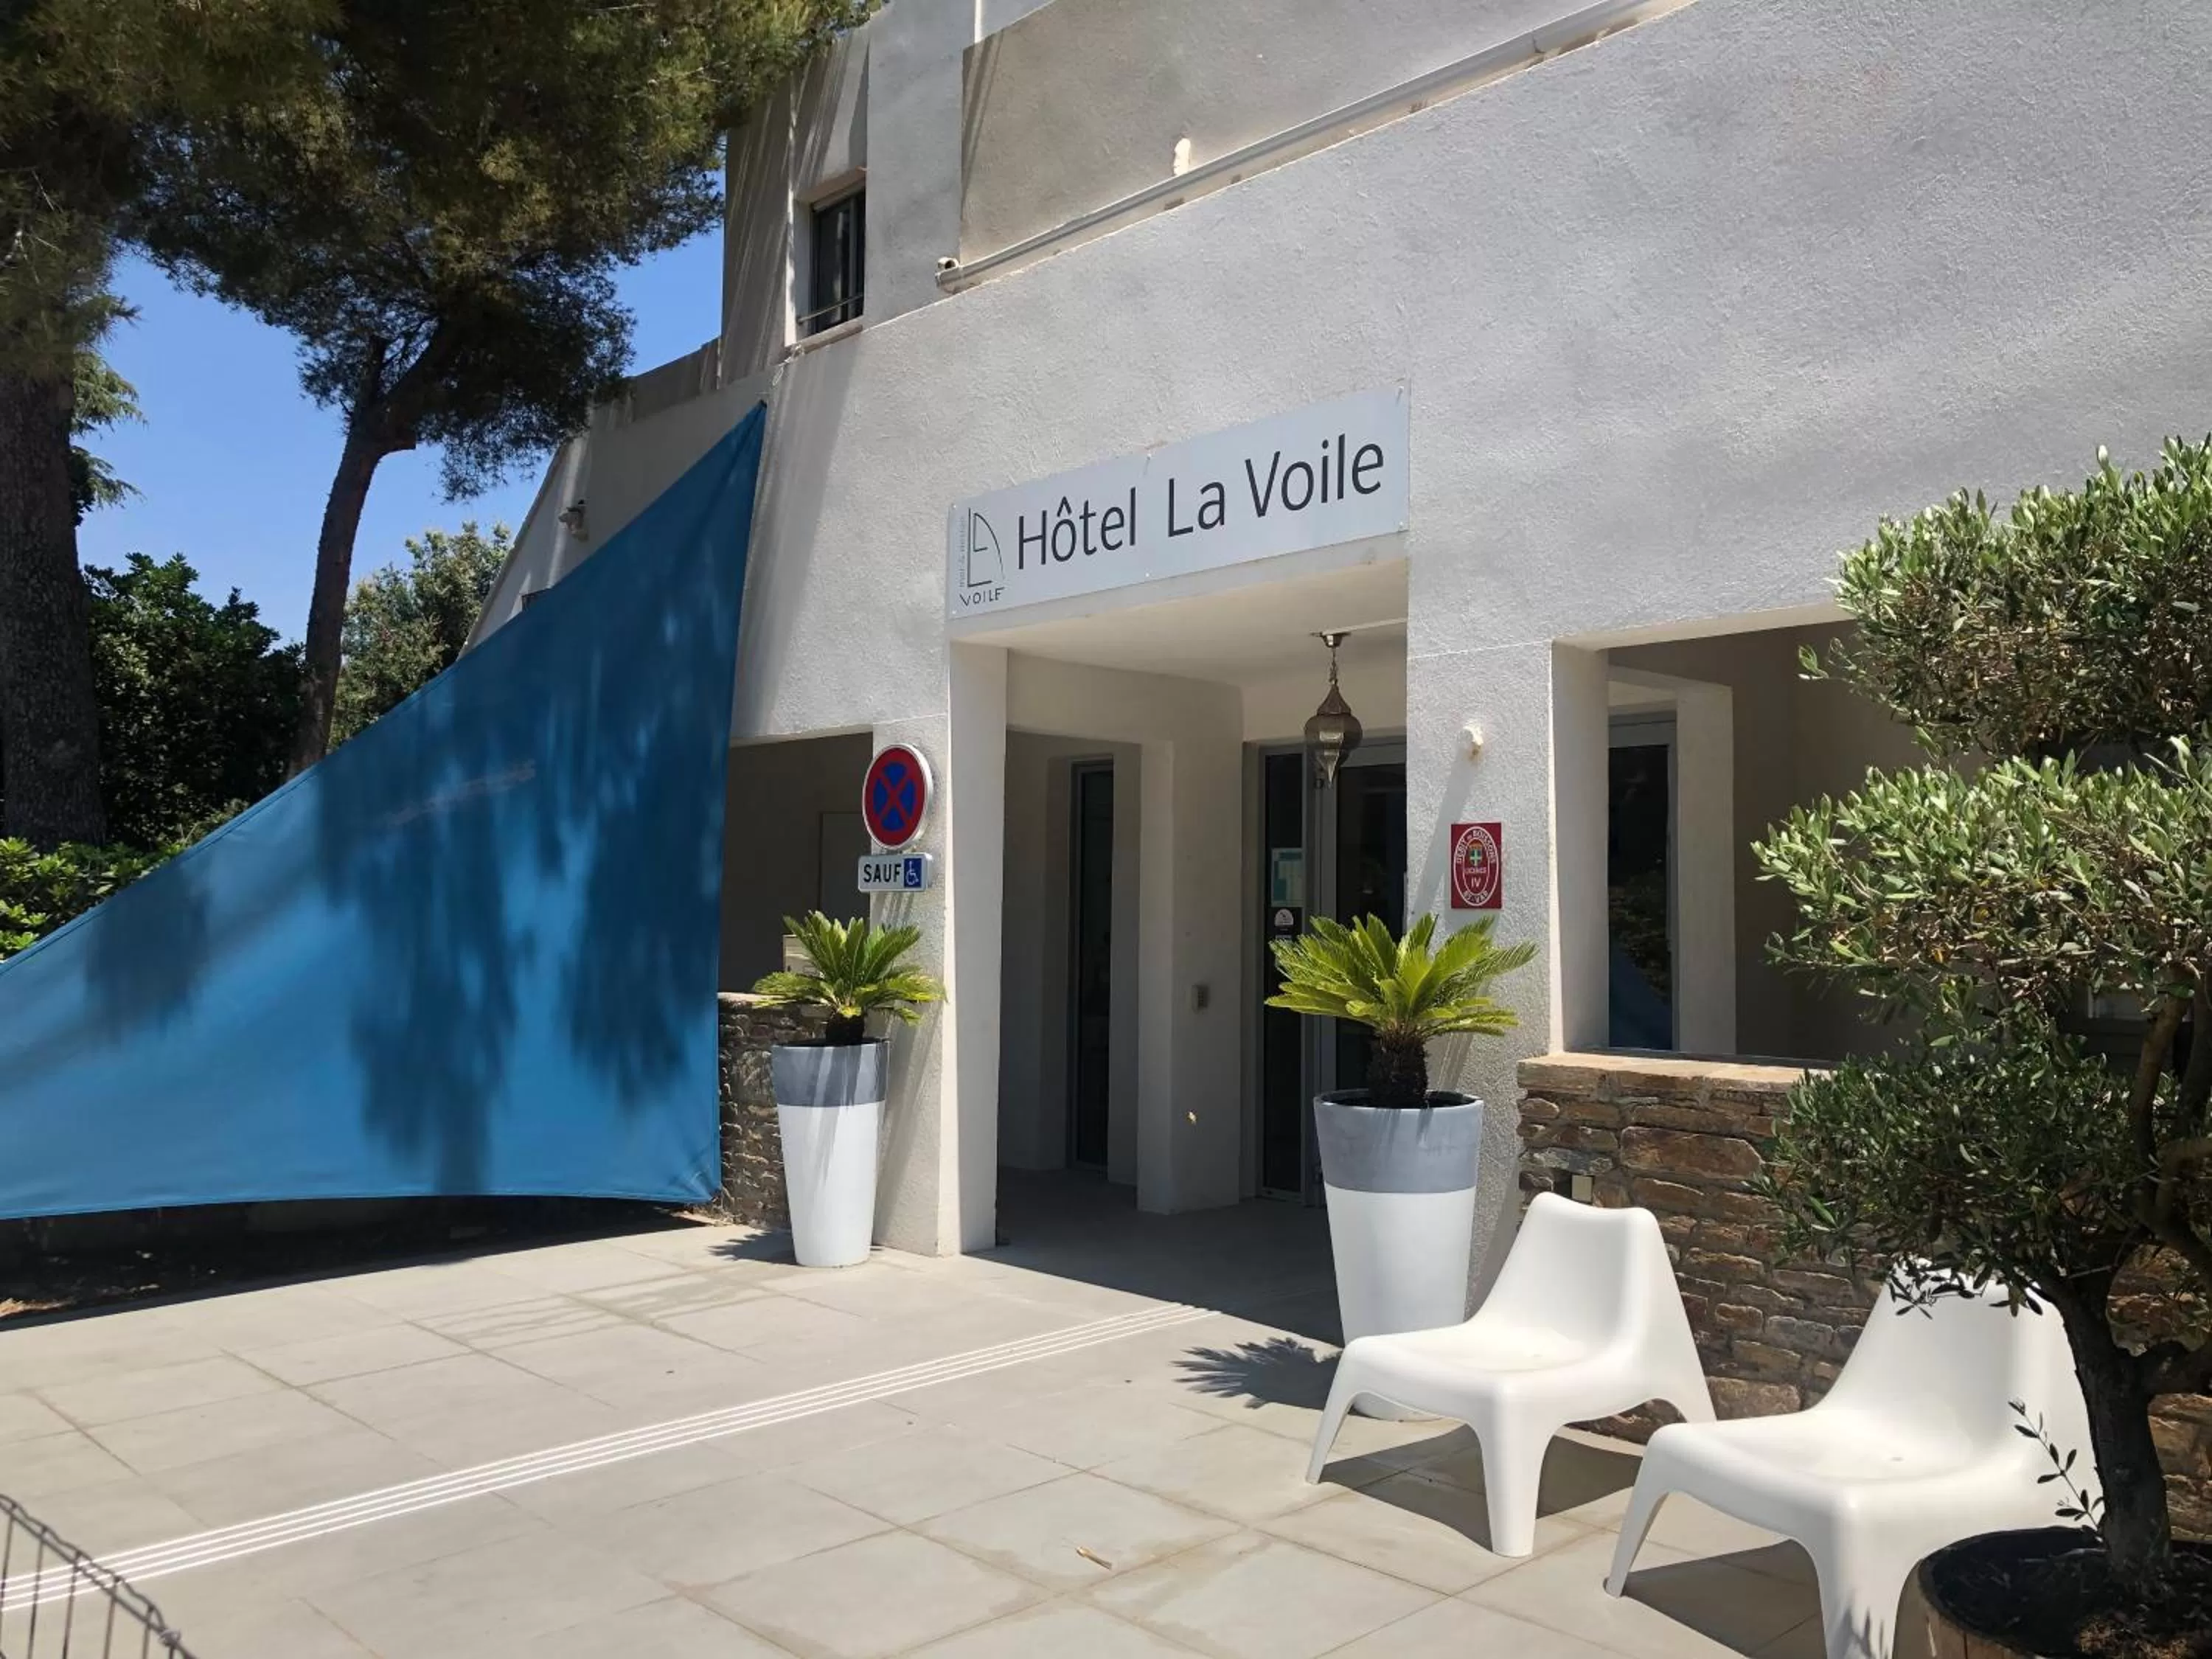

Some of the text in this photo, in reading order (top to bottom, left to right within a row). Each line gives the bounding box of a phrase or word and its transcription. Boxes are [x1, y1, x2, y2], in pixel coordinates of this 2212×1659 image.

[1018, 487, 1136, 570] Hôtel
[1167, 479, 1226, 538] La
[1244, 434, 1384, 518] Voile
[863, 863, 902, 883] SAUF
[1471, 877, 1481, 888] IV
